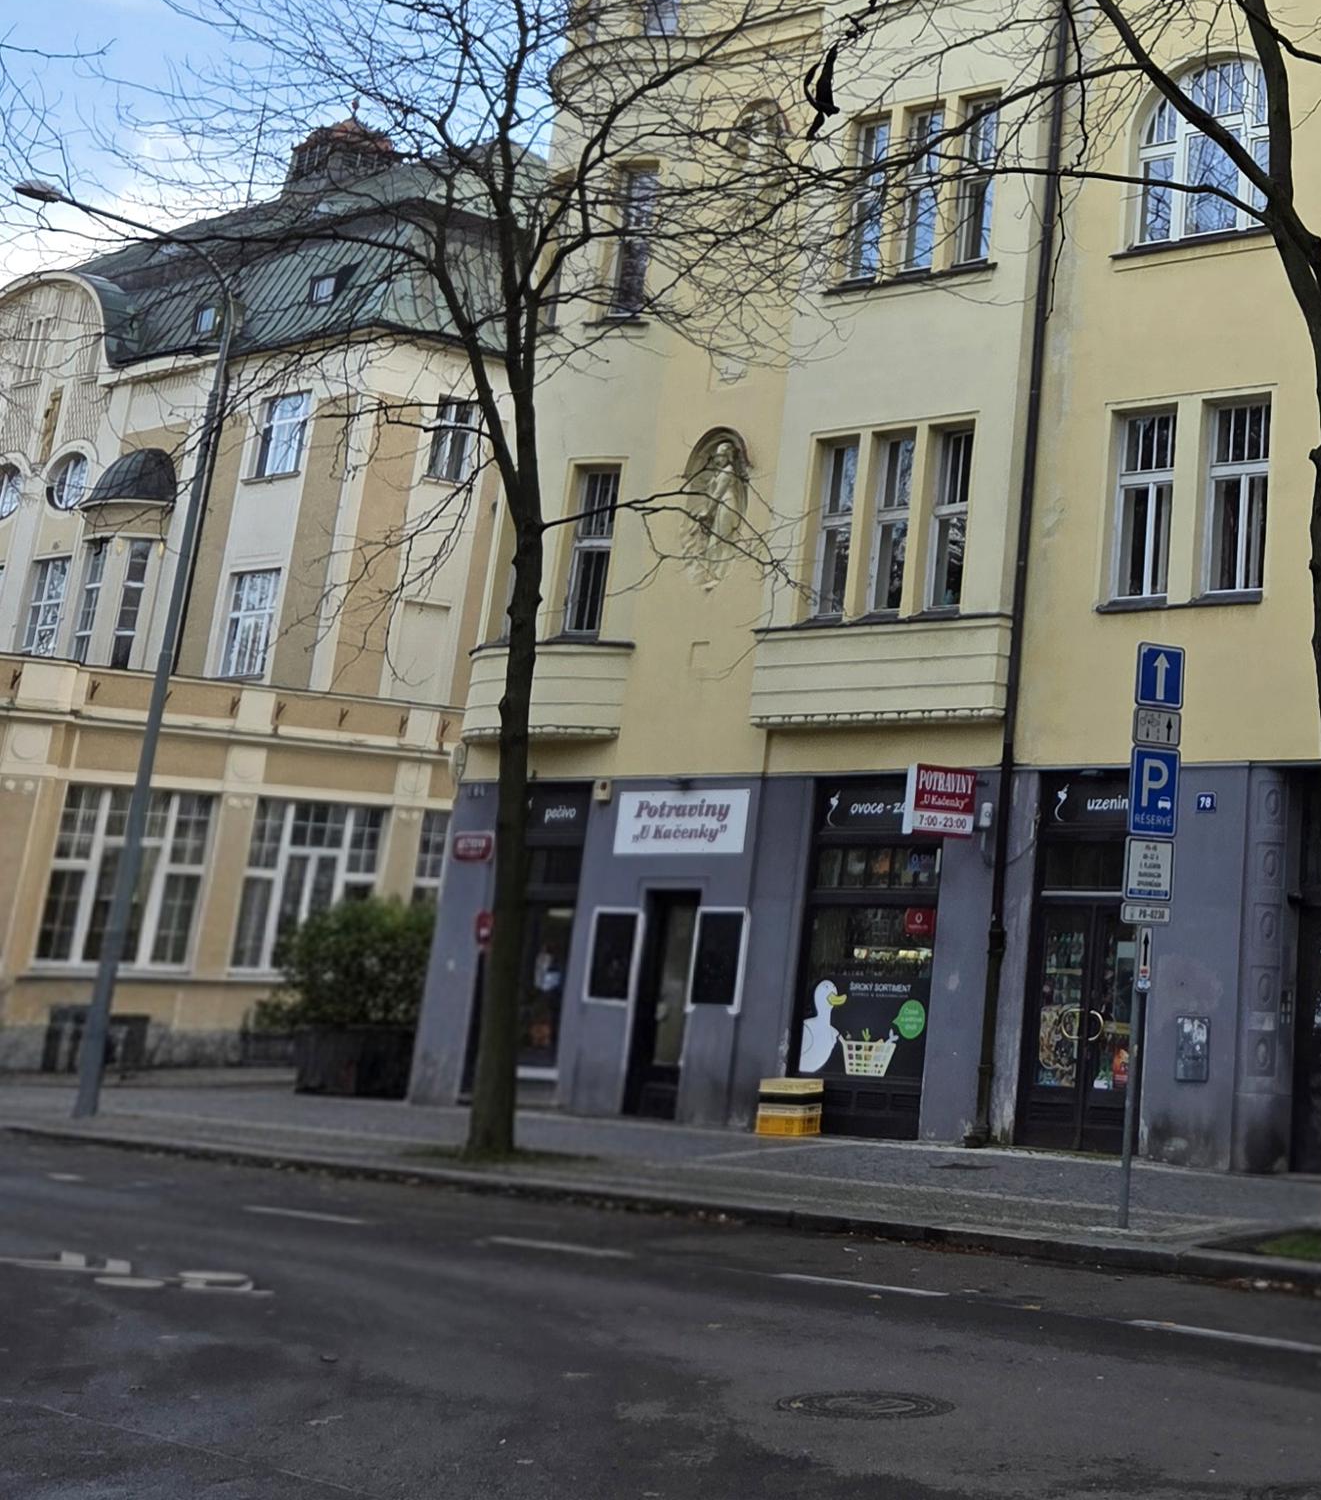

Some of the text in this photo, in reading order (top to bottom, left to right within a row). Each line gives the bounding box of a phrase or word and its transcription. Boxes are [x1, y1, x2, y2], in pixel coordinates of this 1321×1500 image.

[919, 769, 975, 795] POTRAVINY
[1141, 758, 1169, 807] P
[634, 798, 731, 822] Potraviny
[850, 802, 884, 815] ovoce
[1199, 796, 1213, 809] 78
[544, 804, 577, 824] pečivo
[1134, 812, 1172, 826] RÉSERVÉ
